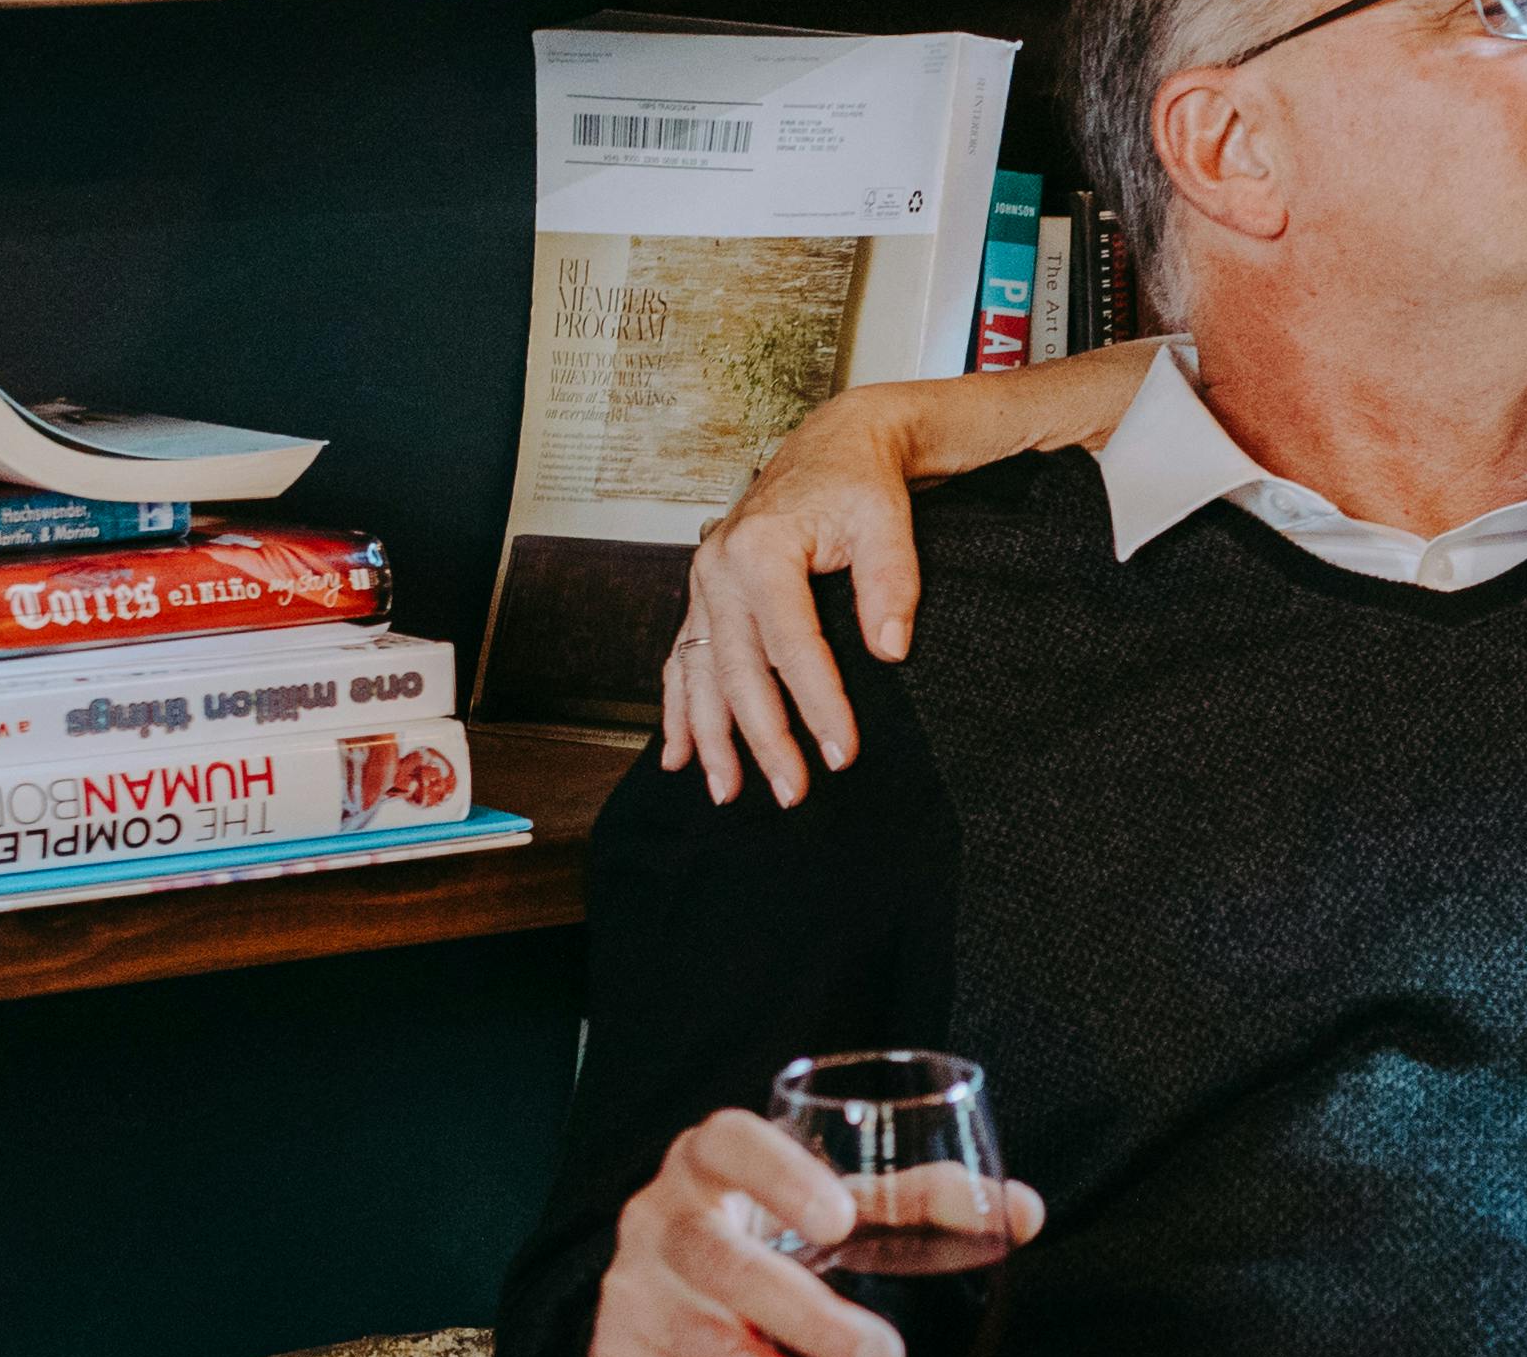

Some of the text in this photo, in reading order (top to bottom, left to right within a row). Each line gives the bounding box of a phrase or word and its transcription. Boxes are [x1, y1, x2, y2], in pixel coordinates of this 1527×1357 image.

[994, 201, 1036, 218] JOHNSON
[558, 257, 590, 285] RH
[558, 286, 669, 315] MEMBERS
[1045, 252, 1063, 333] The Art
[554, 312, 667, 341] PROGRAM
[552, 351, 594, 369] WHAT
[594, 352, 620, 370] YOU
[550, 369, 591, 387] WHEN
[548, 387, 679, 407] Always at SAVINGS
[544, 409, 559, 420] on
[4, 576, 162, 632] Torres
[168, 582, 195, 608] el
[195, 575, 260, 606] Niño
[66, 668, 426, 738] one million things
[17, 720, 31, 734] a
[196, 800, 273, 842] THE
